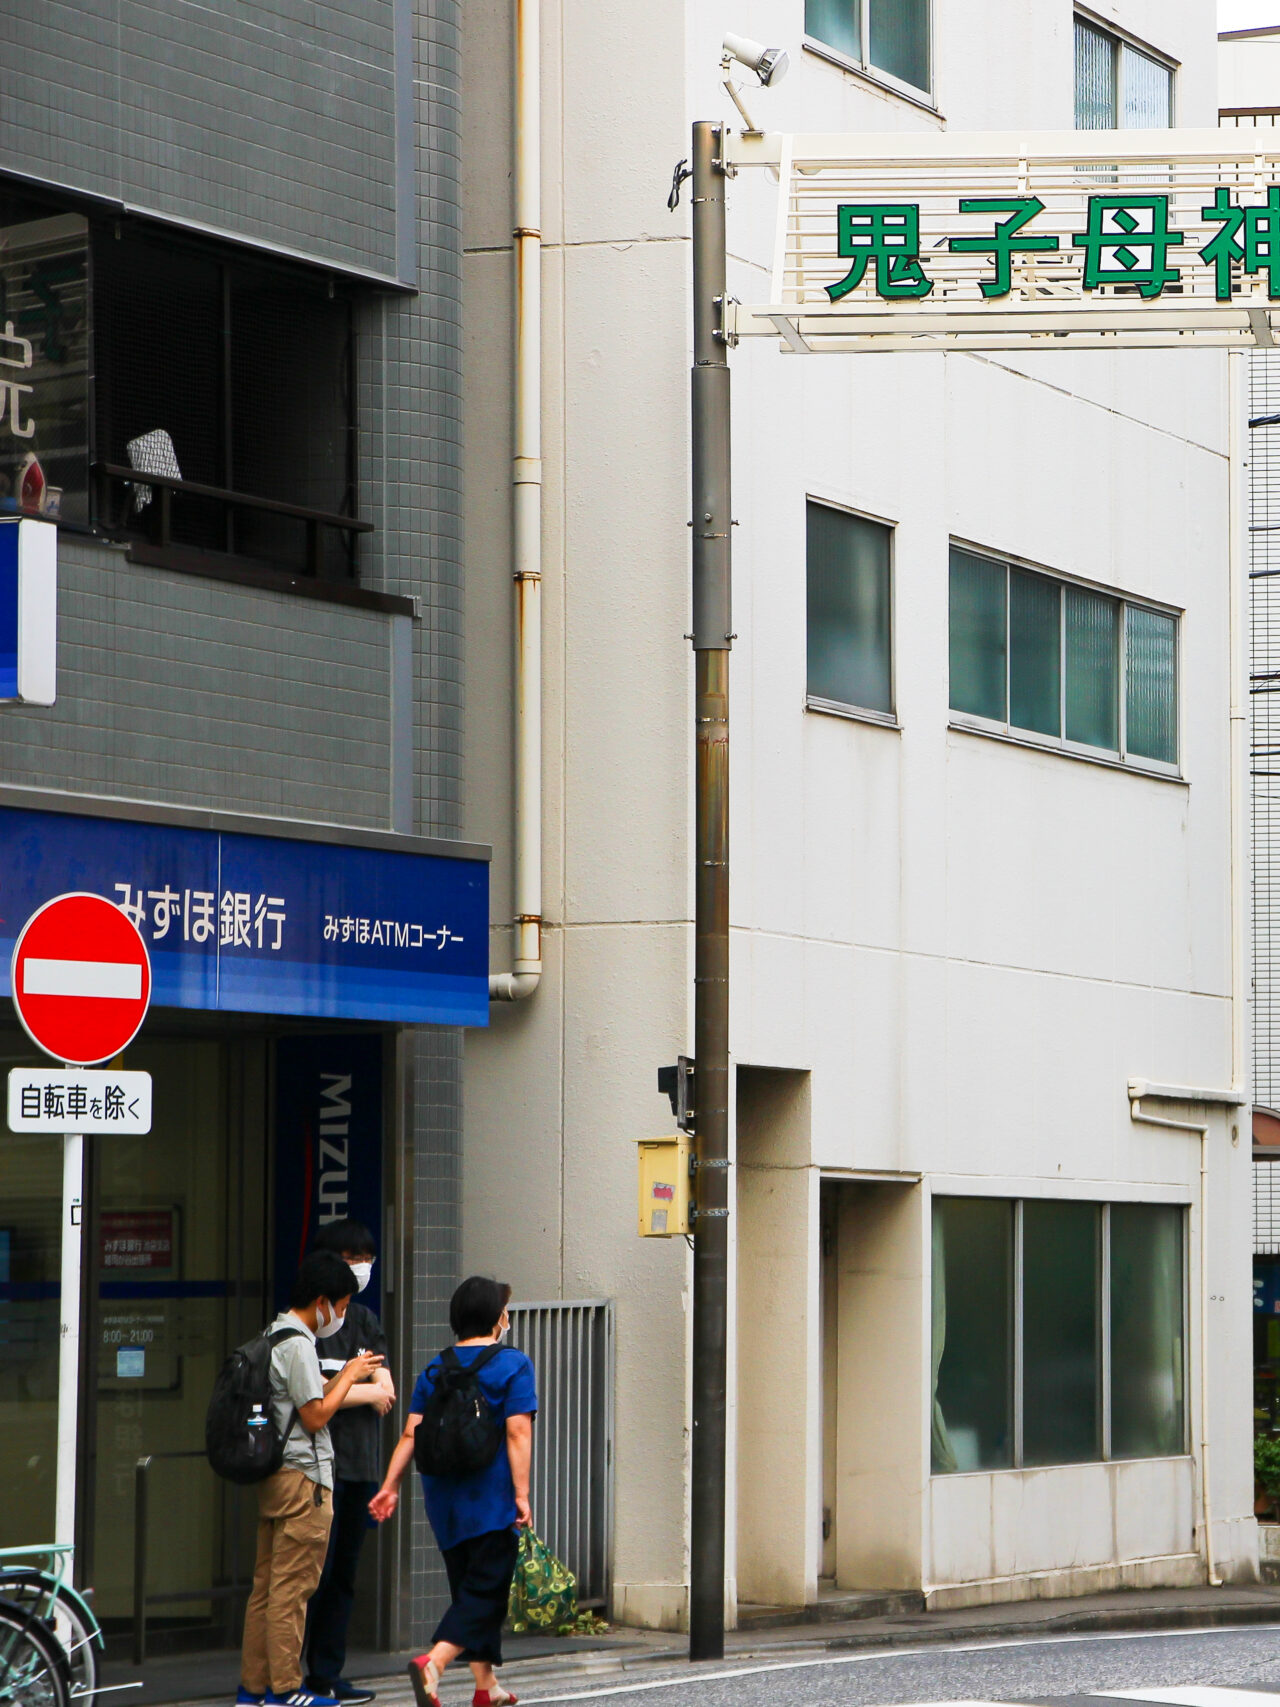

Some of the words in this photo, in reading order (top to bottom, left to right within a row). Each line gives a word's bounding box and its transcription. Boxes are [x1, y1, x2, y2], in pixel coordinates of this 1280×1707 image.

[114, 882, 287, 950] みずほ銀行
[323, 914, 465, 950] みずほATMコーナー
[21, 1083, 141, 1121] 自転車を除く
[318, 1072, 353, 1226] MIZUH
